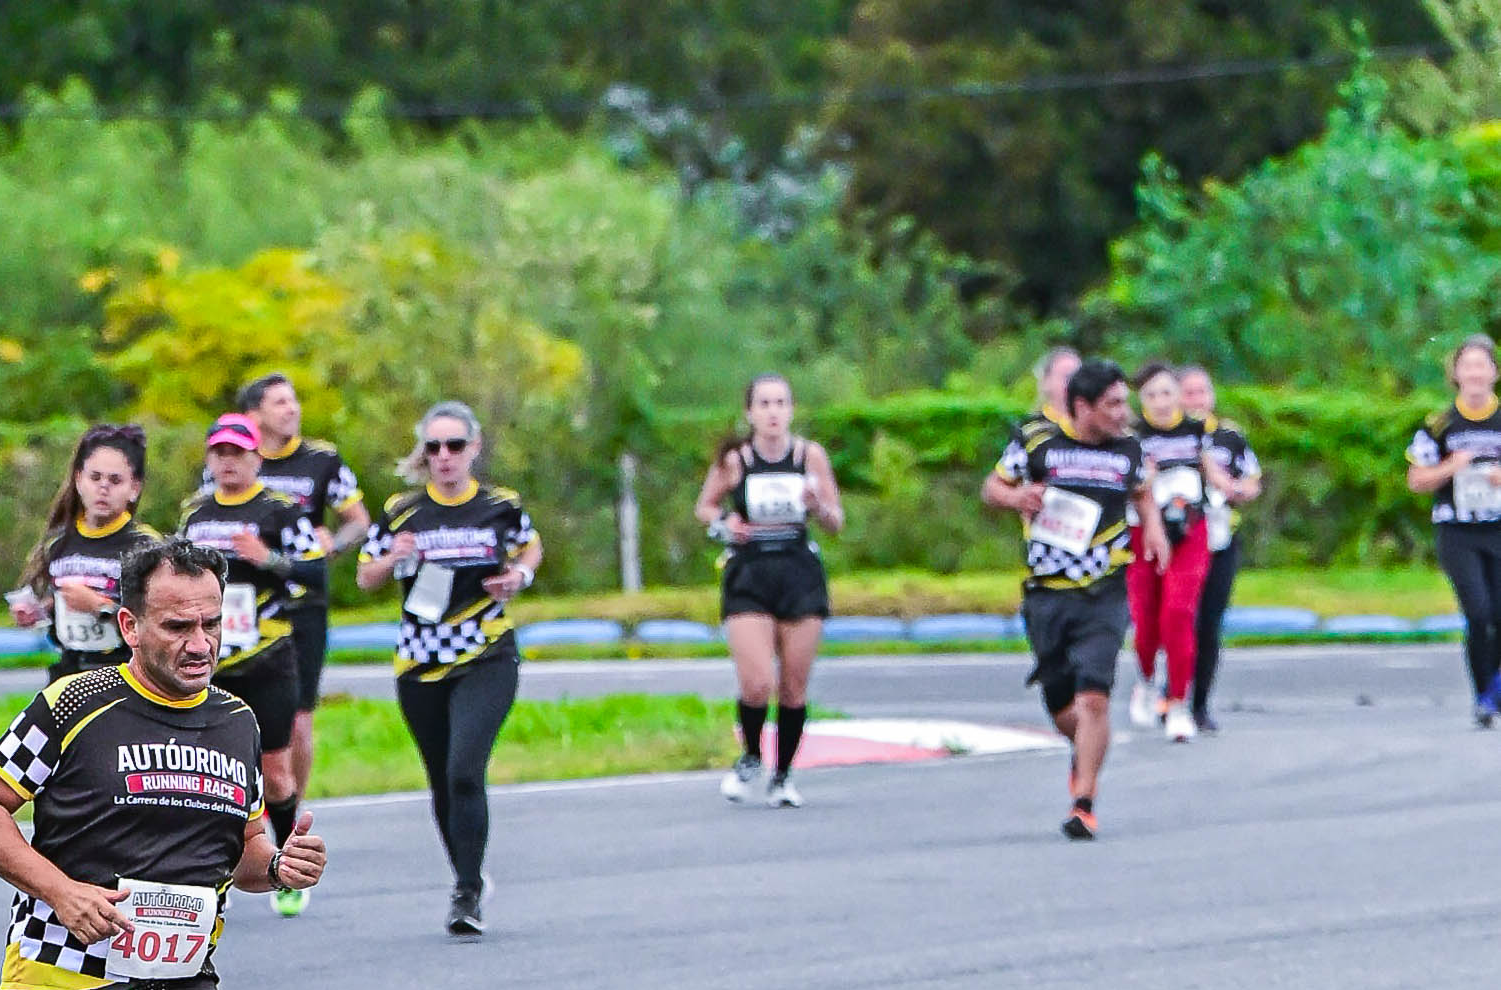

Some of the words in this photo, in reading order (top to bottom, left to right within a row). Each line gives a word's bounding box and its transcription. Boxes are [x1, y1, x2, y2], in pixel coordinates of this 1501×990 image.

[117, 737, 247, 788] AUTÓDROMO
[141, 775, 201, 791] RUNNING
[203, 778, 235, 801] RACE
[114, 795, 126, 805] La
[126, 795, 158, 805] Carrera
[159, 796, 170, 806] de
[171, 797, 183, 807] los
[184, 798, 210, 810] Clubes
[211, 801, 224, 812] del
[132, 888, 204, 913] AUTÓDROMO
[111, 930, 205, 963] 4017
